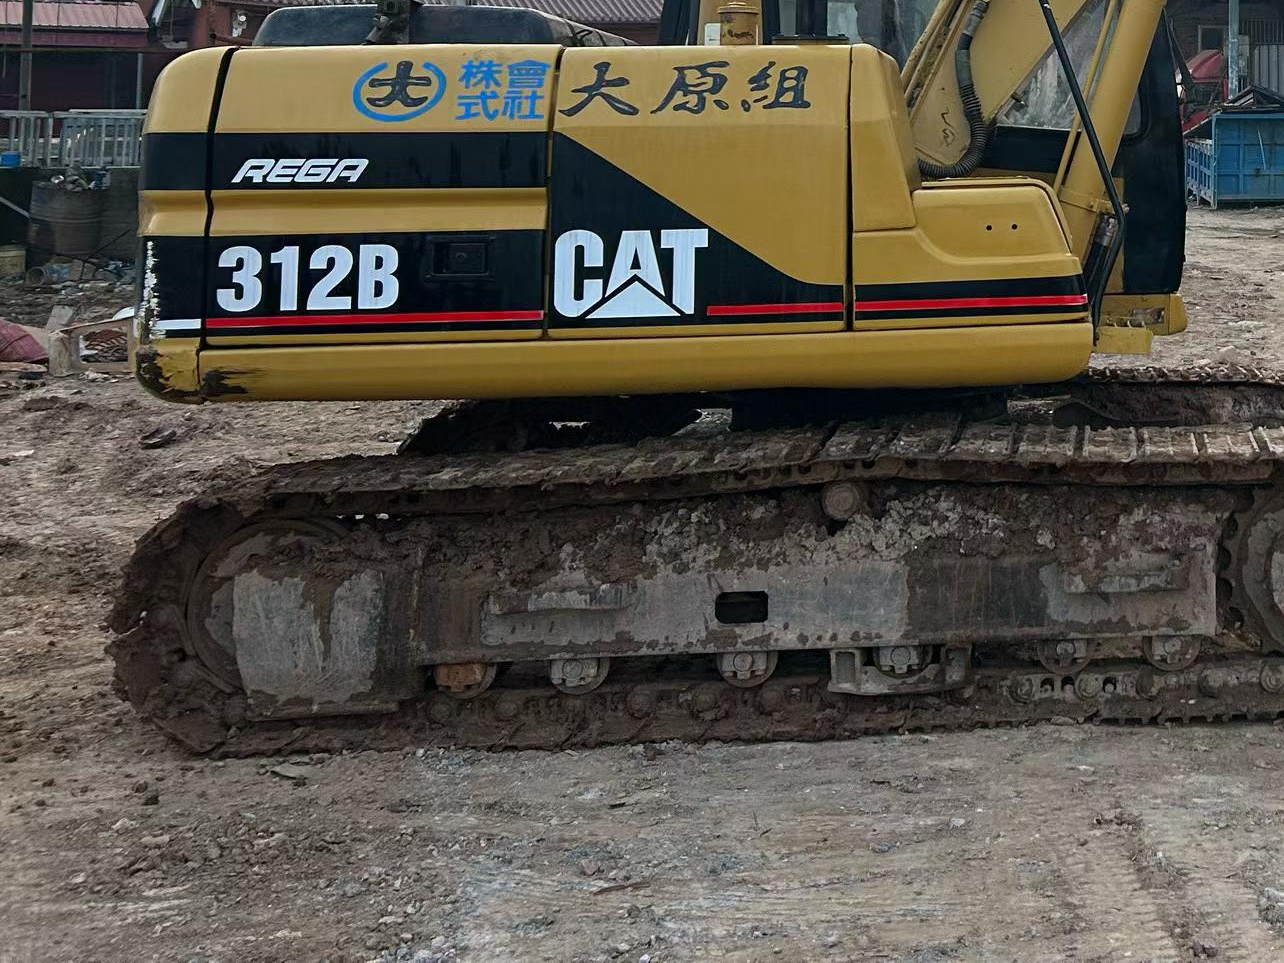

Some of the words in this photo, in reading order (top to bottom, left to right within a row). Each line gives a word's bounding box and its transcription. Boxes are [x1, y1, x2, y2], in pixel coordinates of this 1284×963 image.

[231, 157, 369, 184] REGA
[216, 244, 400, 313] 312B
[553, 228, 709, 319] CAT
